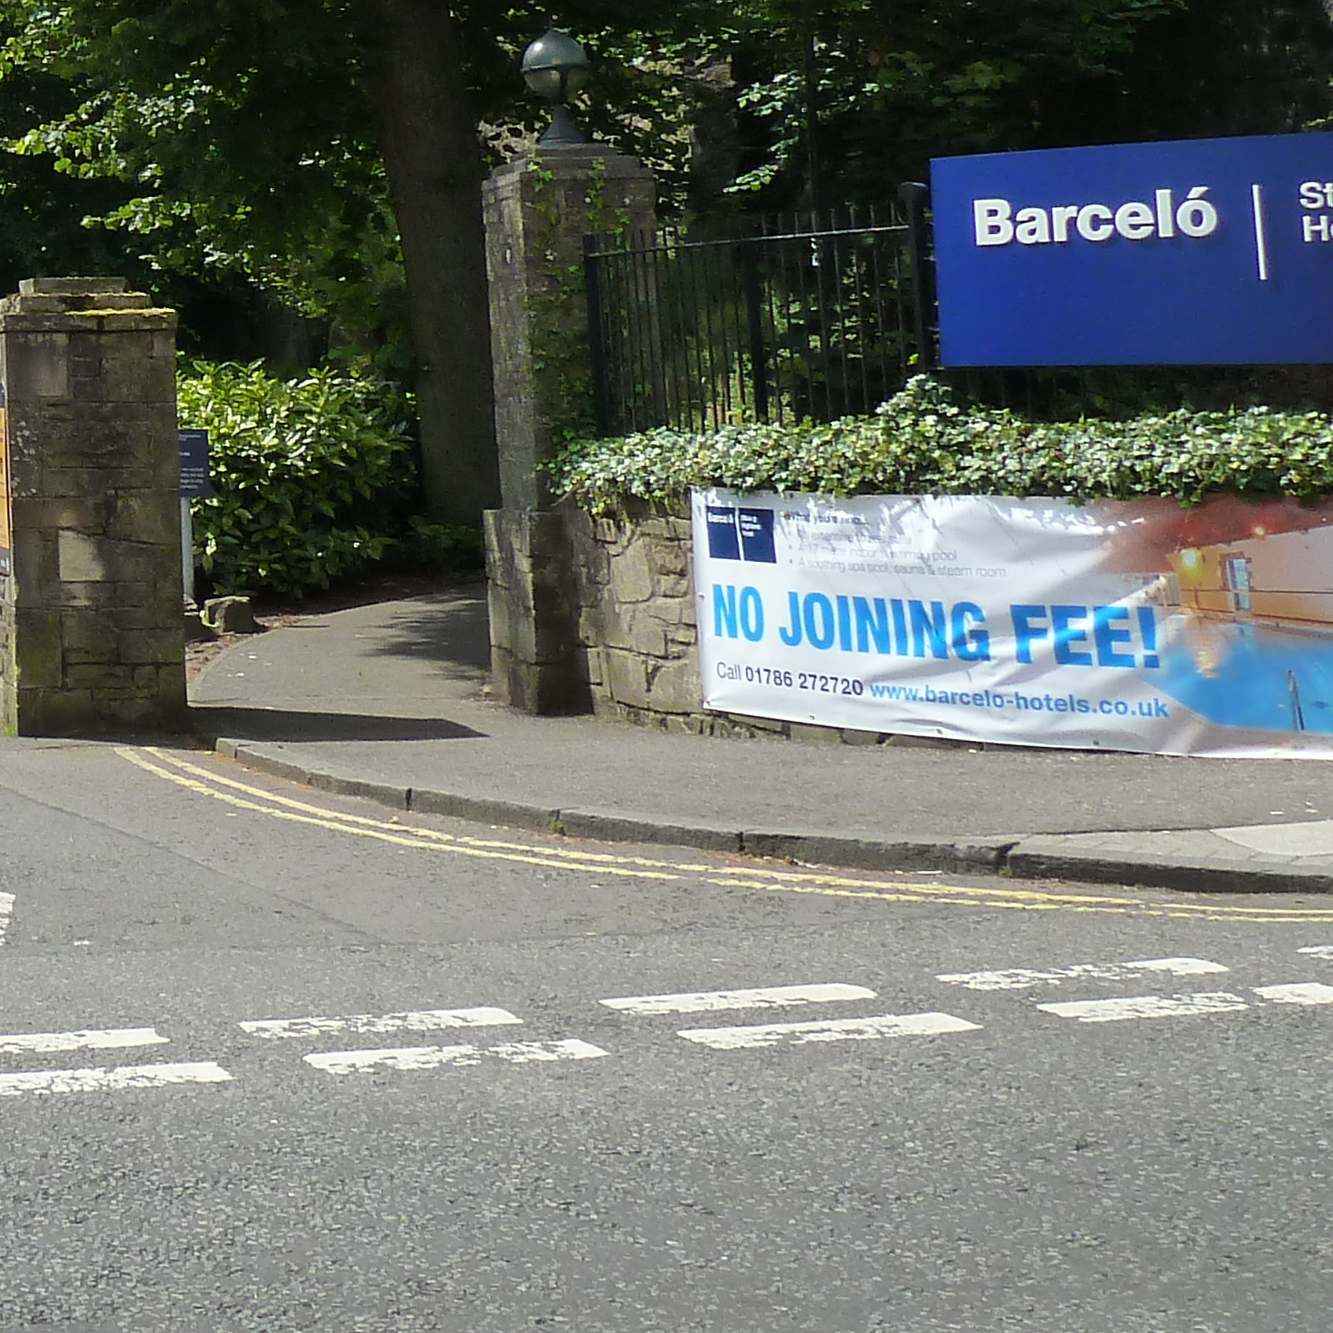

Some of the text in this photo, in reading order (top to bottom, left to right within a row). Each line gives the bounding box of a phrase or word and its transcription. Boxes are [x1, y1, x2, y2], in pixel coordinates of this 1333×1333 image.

[973, 186, 1218, 246] Barceló
[1302, 215, 1333, 243] H
[932, 550, 958, 562] pool
[975, 567, 1007, 577] room
[712, 583, 1161, 669] NO JOINING FEE!
[716, 661, 1170, 718] Call 01786 272720 www.barcelo-hotels.co.uk
